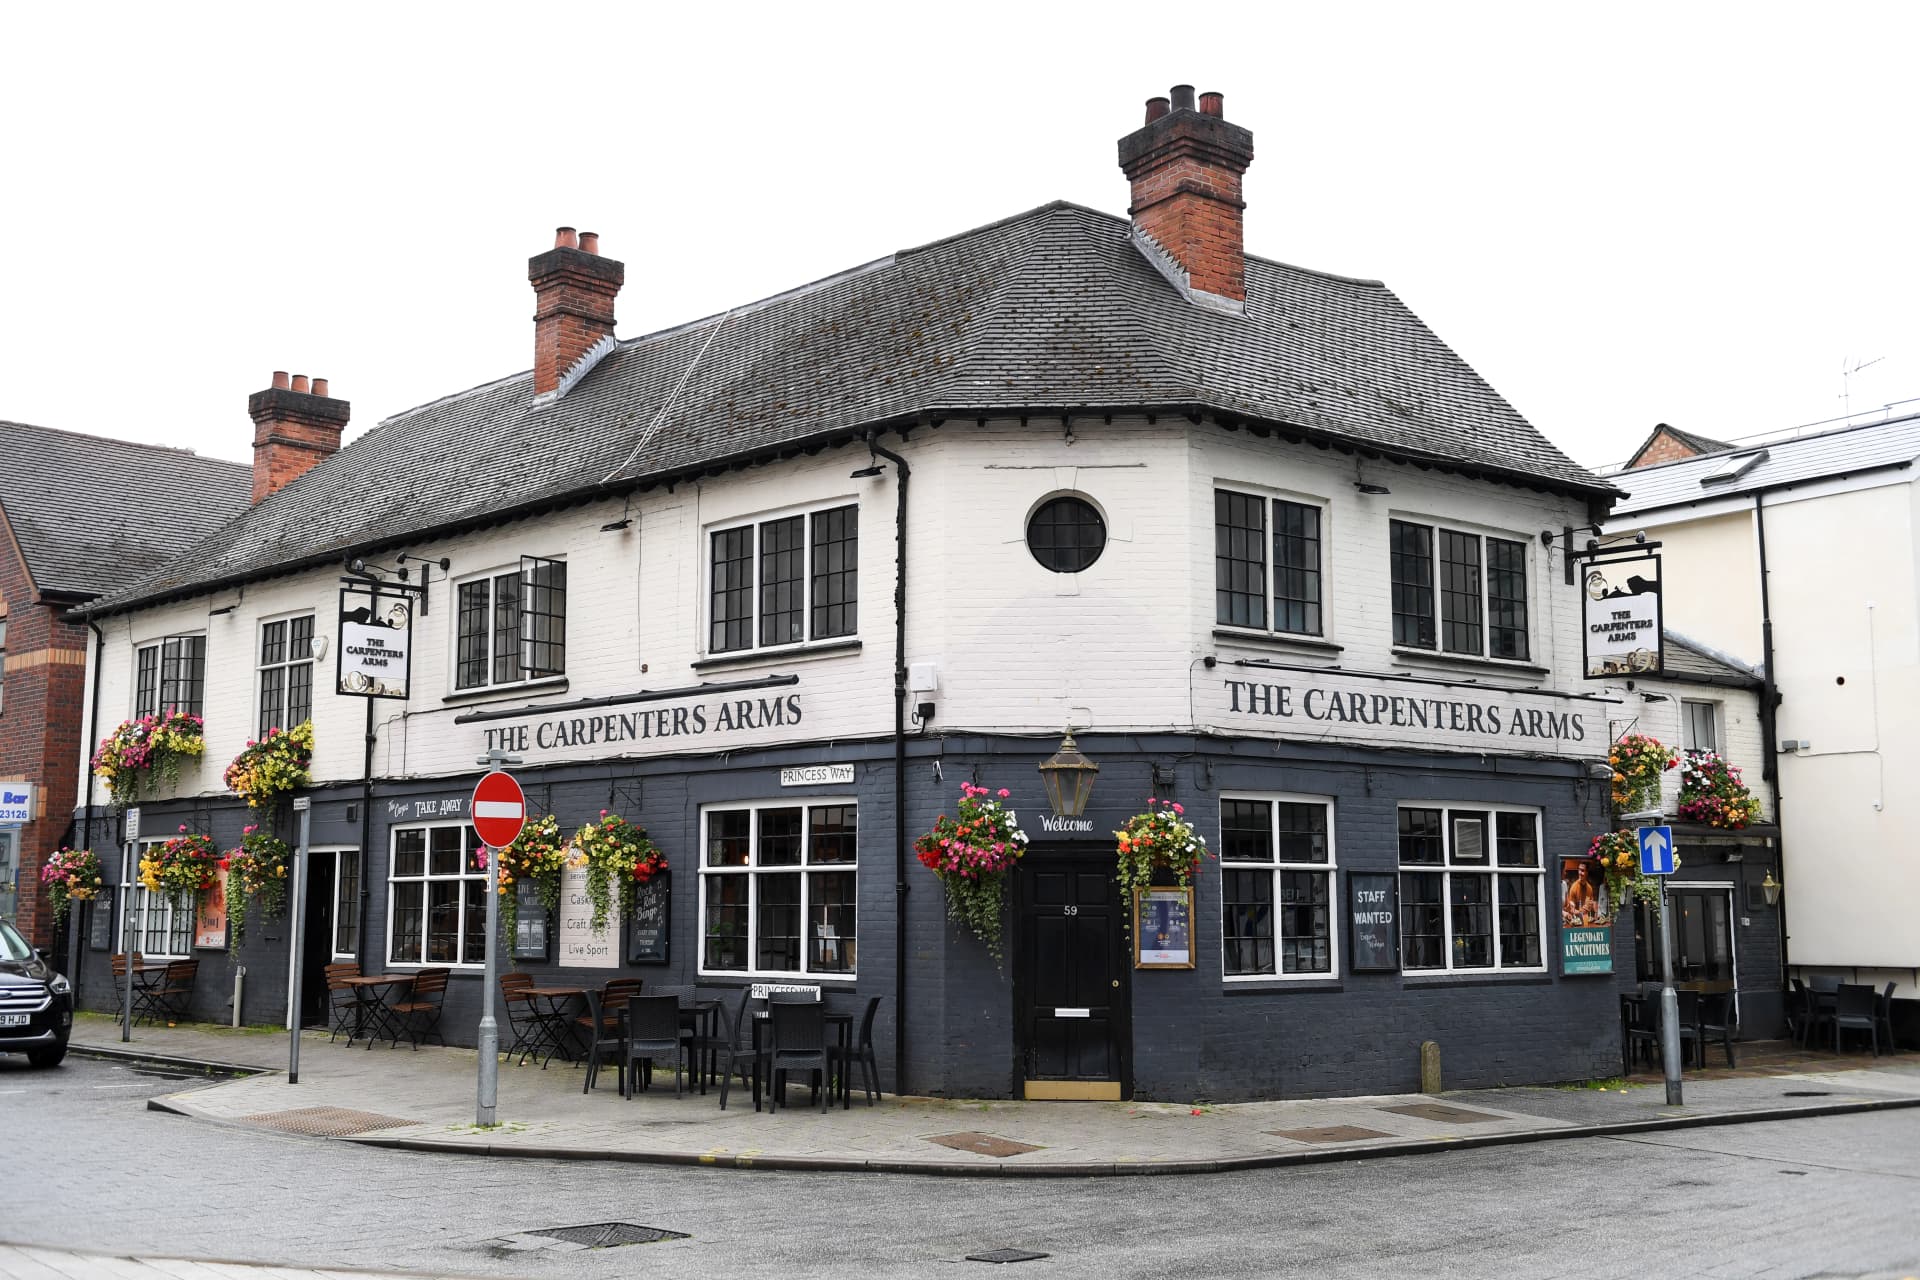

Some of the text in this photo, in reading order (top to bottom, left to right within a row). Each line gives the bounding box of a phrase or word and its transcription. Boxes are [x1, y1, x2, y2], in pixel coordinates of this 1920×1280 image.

[1611, 611, 1631, 620] THE
[1591, 619, 1653, 632] CARPENTERS
[366, 638, 385, 647] THE
[1608, 632, 1636, 643] ARMS
[346, 646, 403, 659] CARPENTERS
[361, 657, 388, 667] ARMS
[1224, 680, 1585, 742] THE CARPENTERS ARMS
[484, 694, 802, 752] THE CARPENTERS ARMS
[783, 767, 851, 782] PRINCESS WAY
[3, 792, 28, 804] Bar
[0, 810, 27, 819] 23126
[415, 800, 437, 817] TAKE
[439, 799, 463, 815] AWAY
[1039, 814, 1094, 832] Welcome
[1357, 890, 1386, 903] STAFF
[636, 906, 657, 921] Bingo
[1063, 905, 1078, 916] 59
[567, 918, 586, 930] Craft
[1354, 911, 1392, 925] WANTED
[1569, 931, 1604, 943] LEGENDARY
[568, 944, 608, 957] Live Sport
[1565, 943, 1610, 957] LUNCHTIMES
[8, 1015, 27, 1024] HJD
